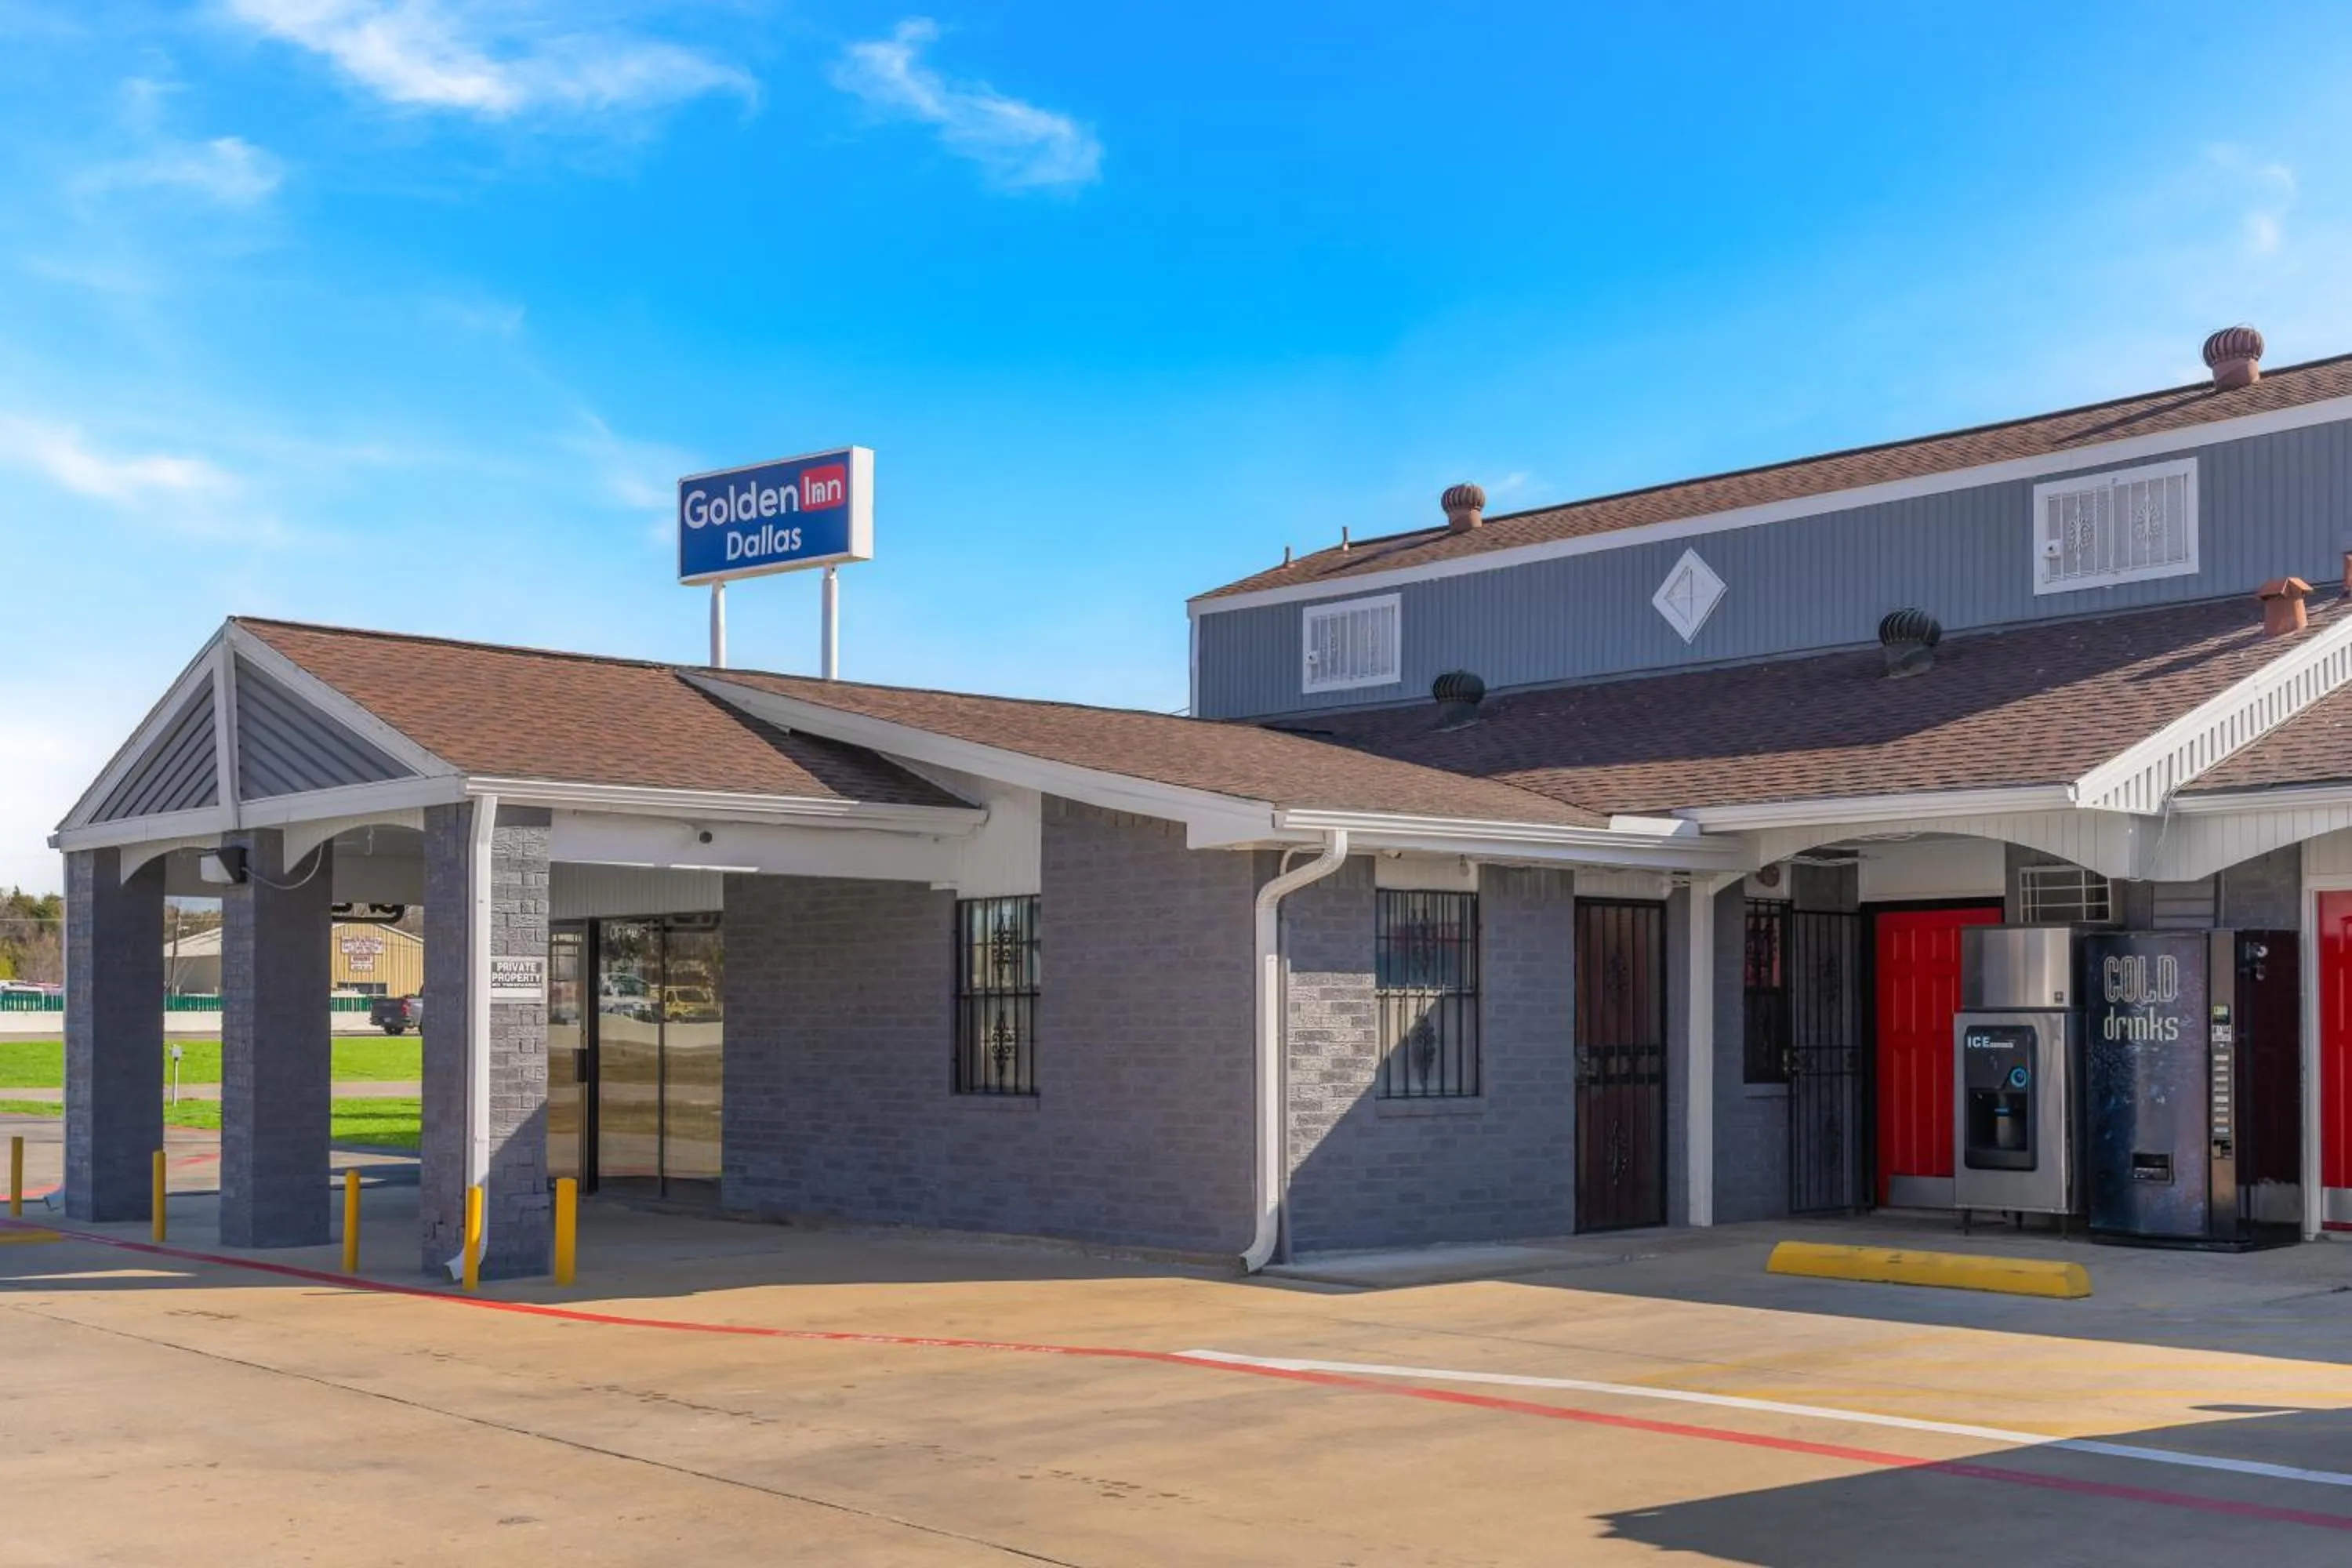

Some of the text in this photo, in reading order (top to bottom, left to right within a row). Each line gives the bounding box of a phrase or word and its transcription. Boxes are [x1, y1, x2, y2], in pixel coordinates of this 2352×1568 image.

[684, 477, 841, 529] Golden Inn
[727, 524, 802, 561] Dallas
[492, 972, 540, 982] PROPERTY
[496, 962, 536, 972] PRIVATE
[2103, 955, 2178, 1003] COLD
[2103, 1006, 2179, 1041] drinks
[1967, 1036, 1990, 1048] ICE
